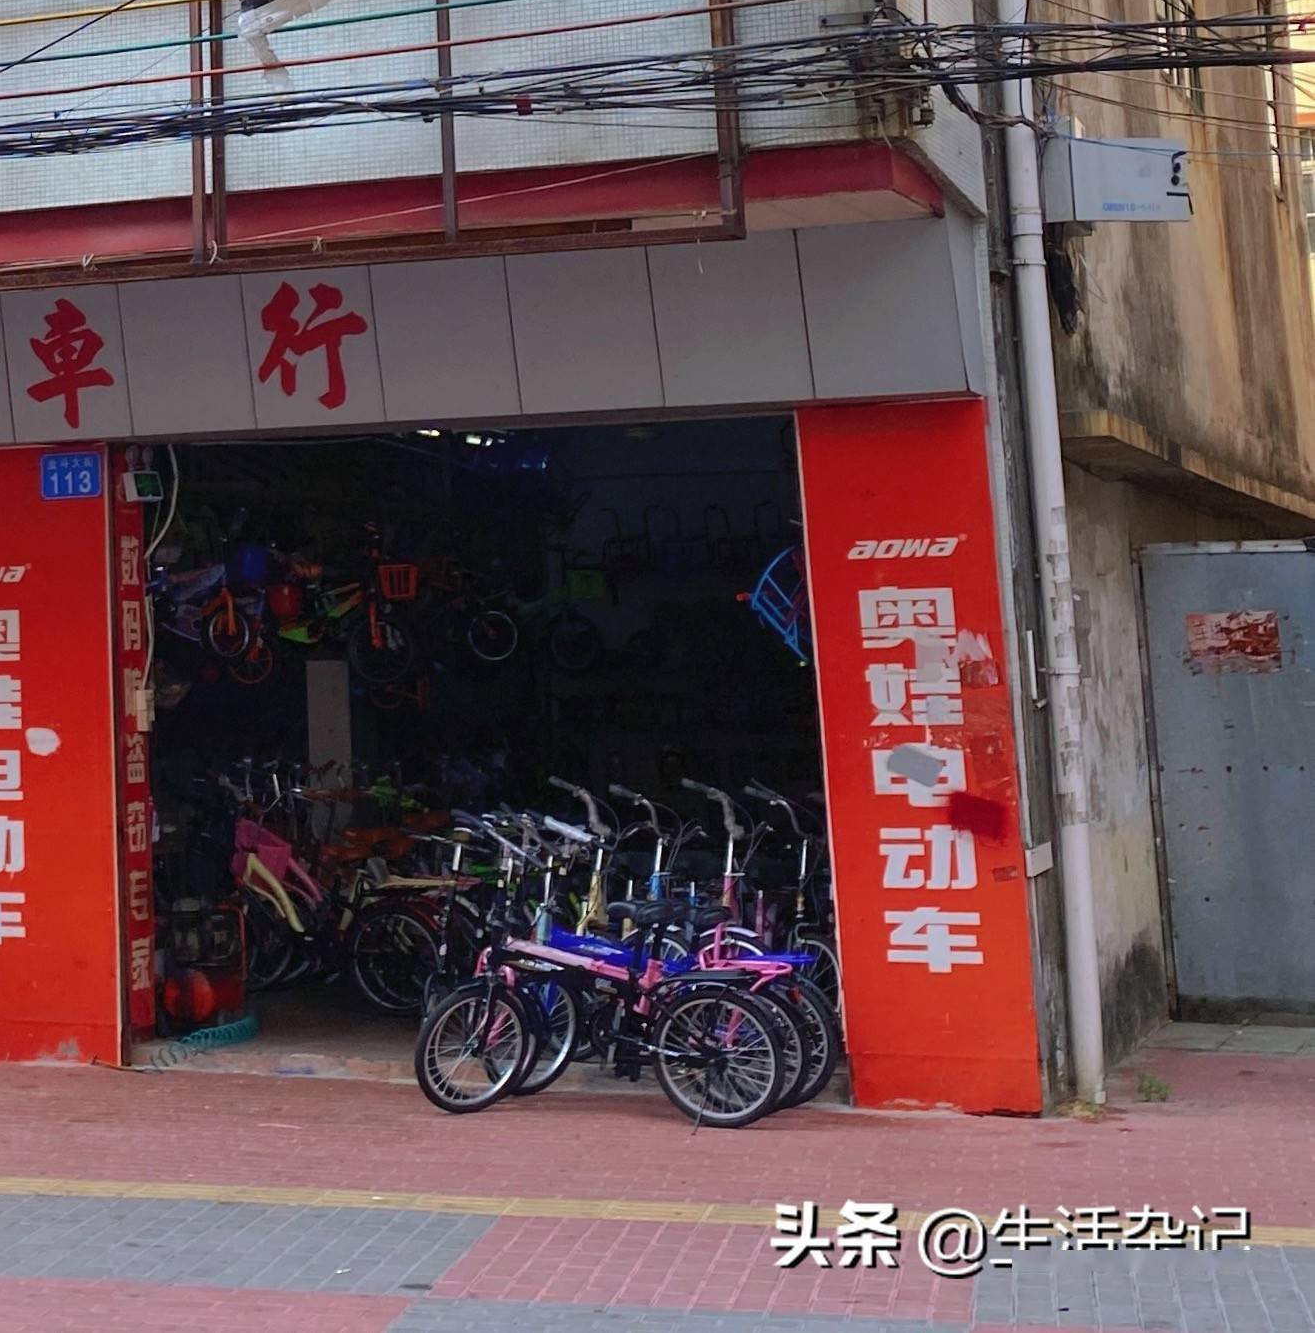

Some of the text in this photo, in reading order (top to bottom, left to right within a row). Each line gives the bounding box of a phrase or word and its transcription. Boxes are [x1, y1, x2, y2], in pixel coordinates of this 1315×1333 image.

[50, 471, 92, 495] 113
[858, 586, 984, 974] 奥娃电动车
